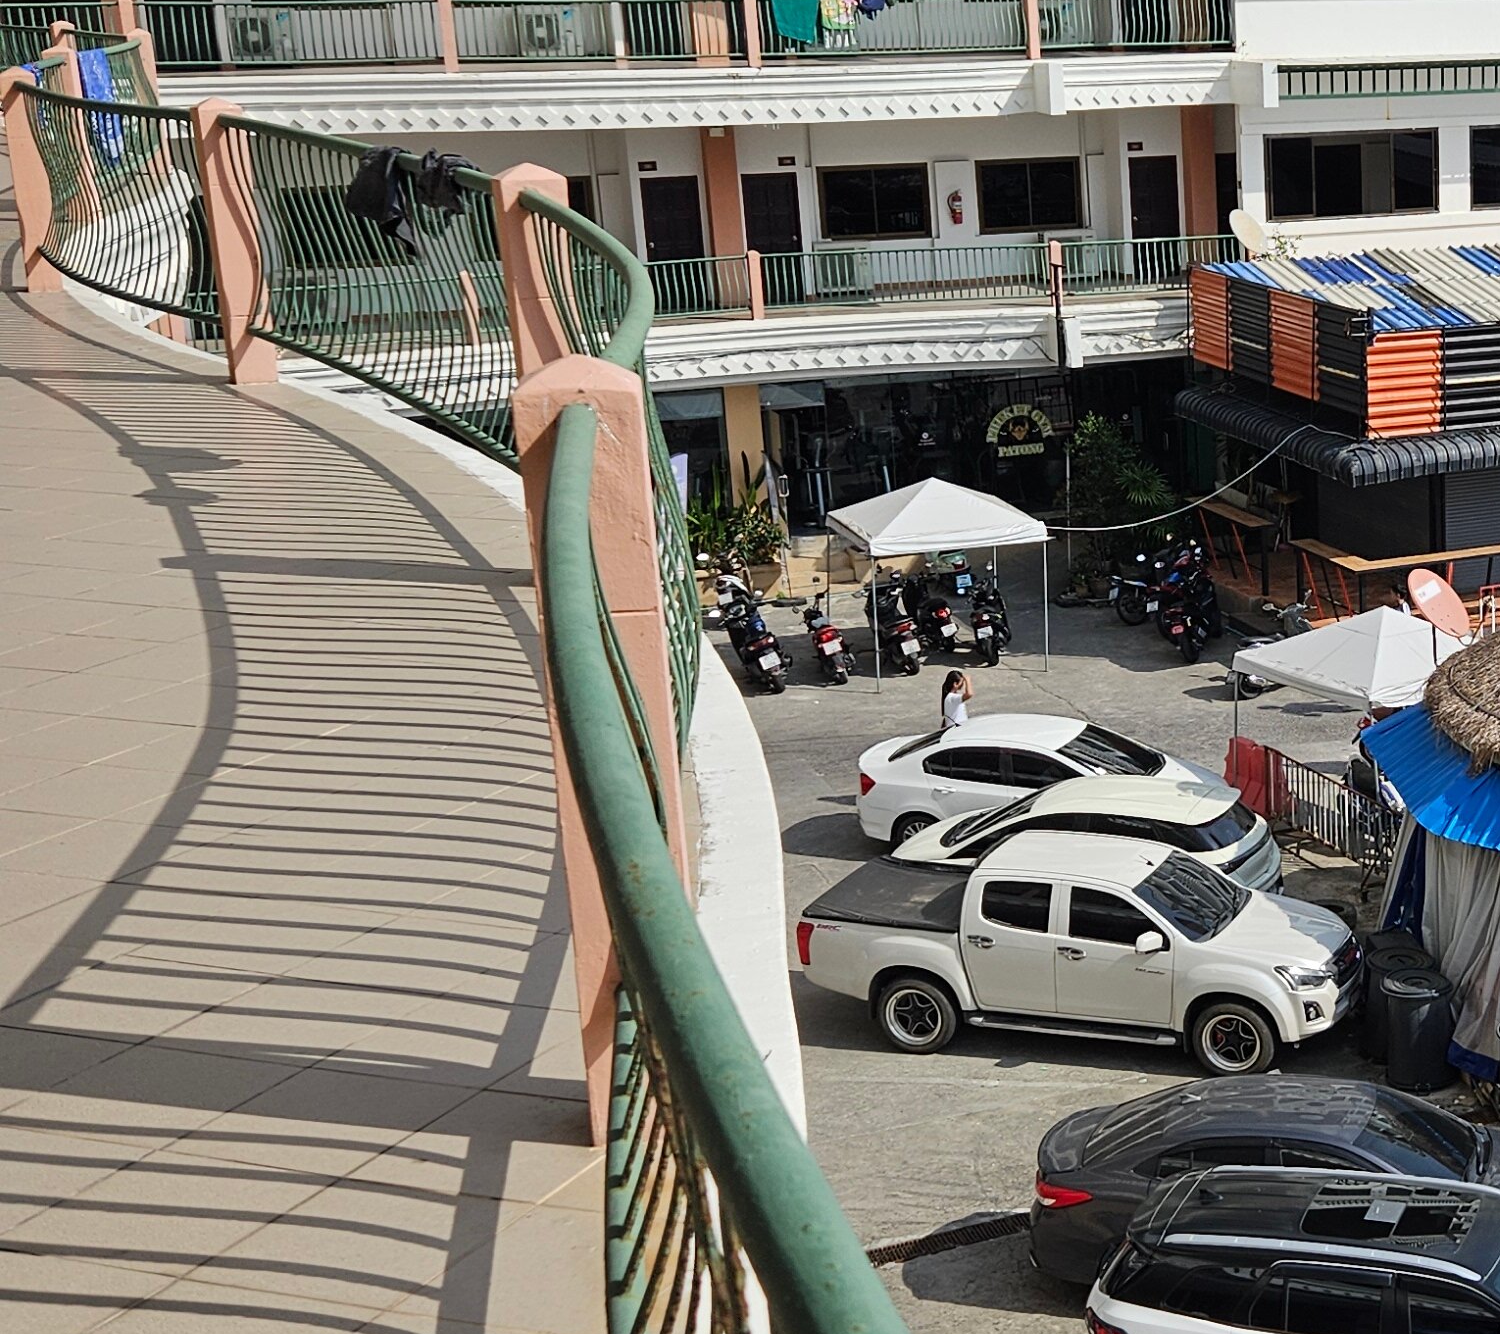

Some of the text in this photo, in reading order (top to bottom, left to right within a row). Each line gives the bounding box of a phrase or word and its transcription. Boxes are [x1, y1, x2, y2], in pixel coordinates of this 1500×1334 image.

[986, 404, 1055, 443] PHUKET GYM
[997, 442, 1045, 458] PATONG
